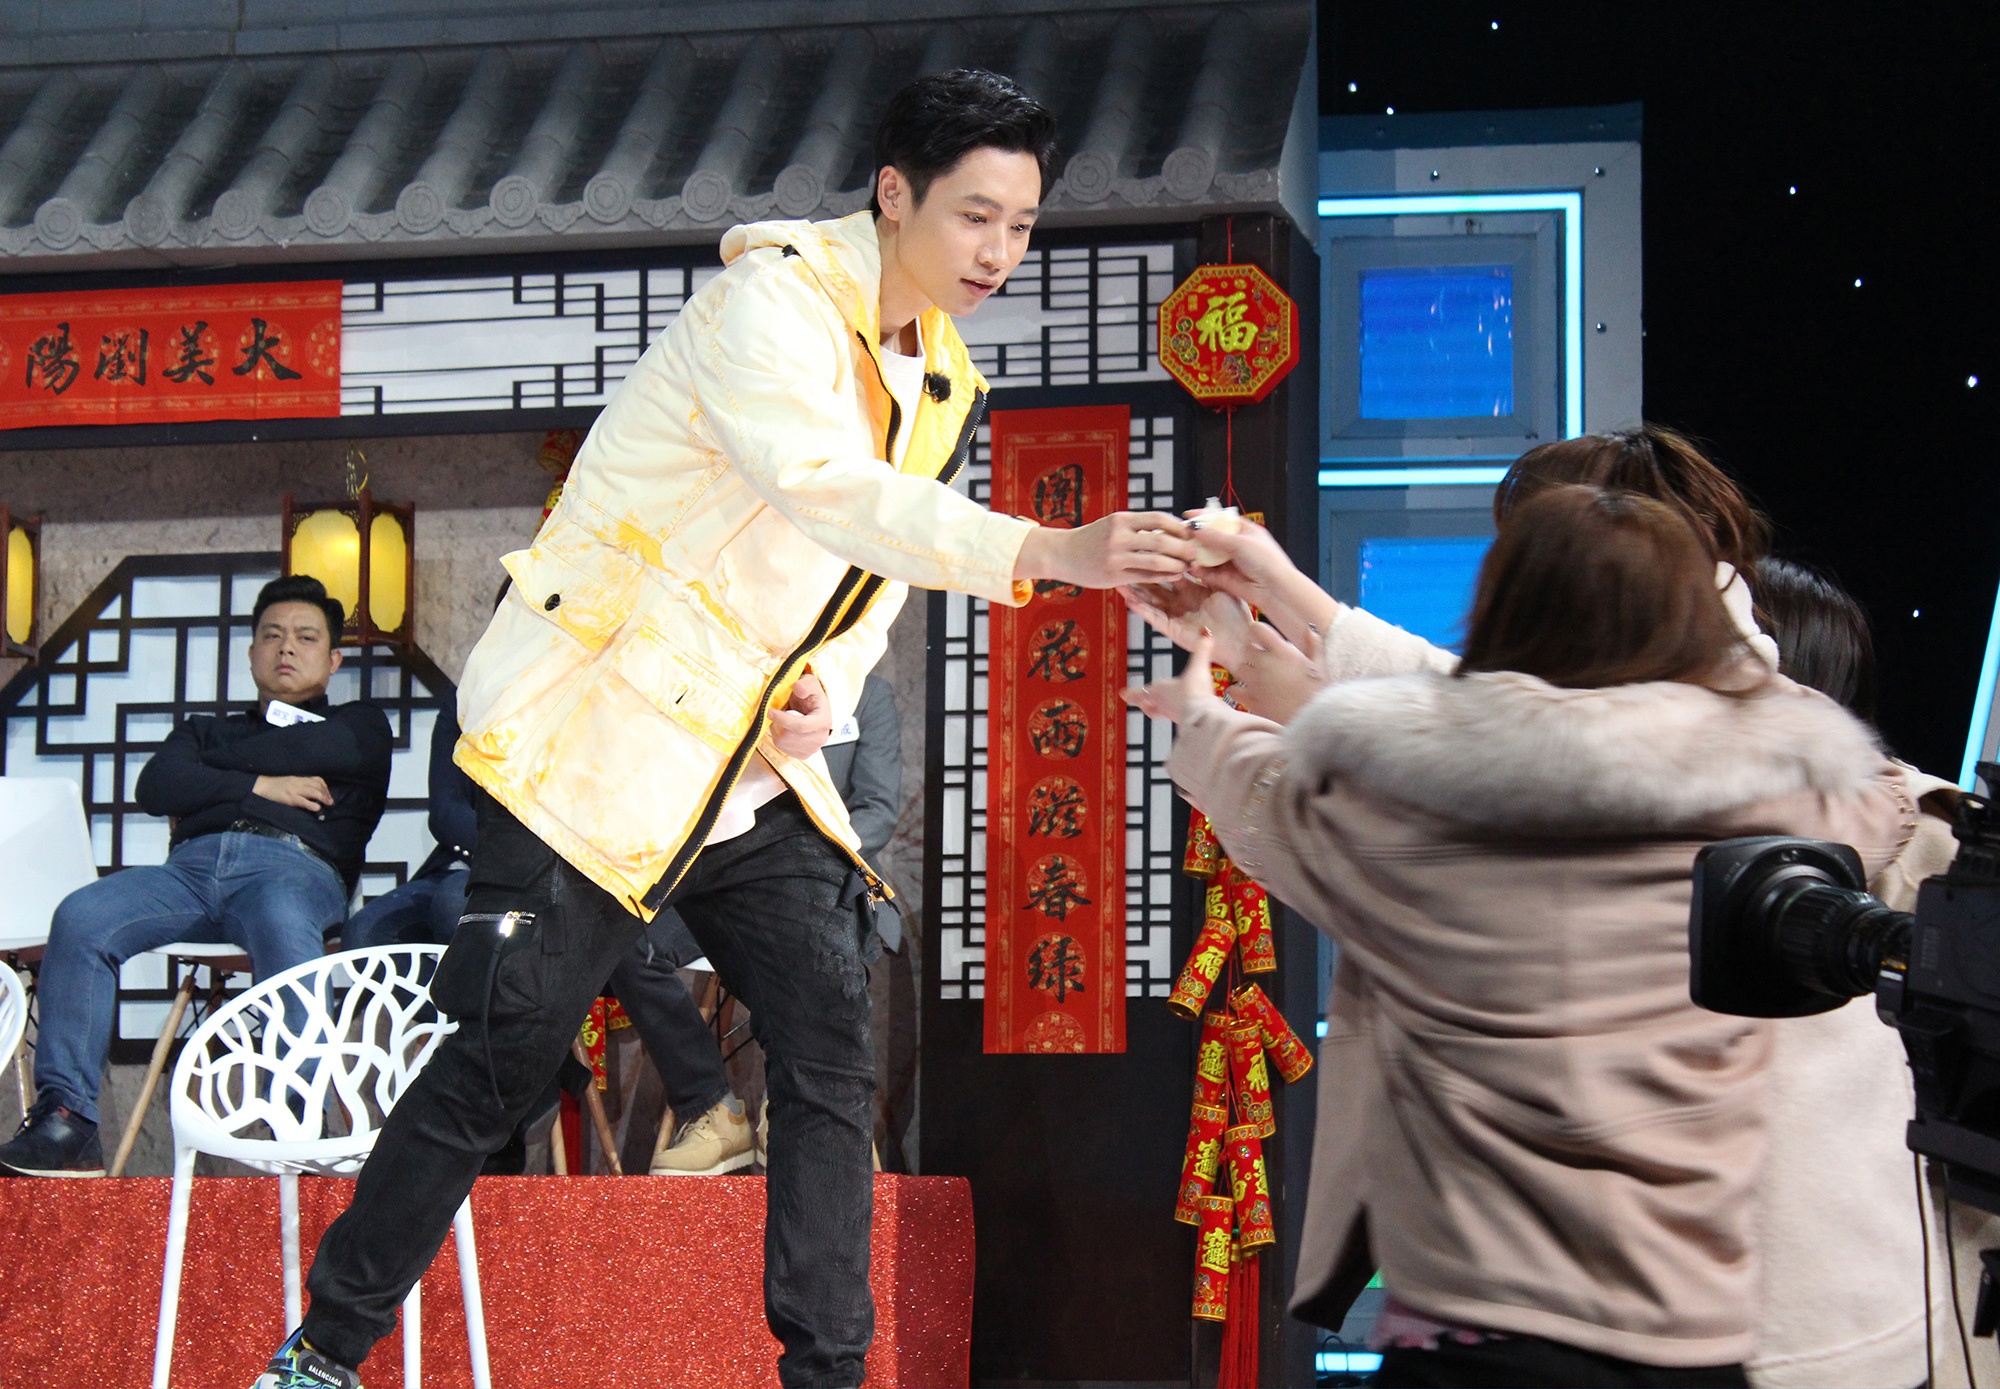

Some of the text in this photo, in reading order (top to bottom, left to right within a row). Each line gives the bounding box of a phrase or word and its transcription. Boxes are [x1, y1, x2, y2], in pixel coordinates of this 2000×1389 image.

[1195, 291, 1259, 353] 福
[1193, 945, 1226, 984] 福
[308, 1363, 343, 1388] BALENCIAGA
